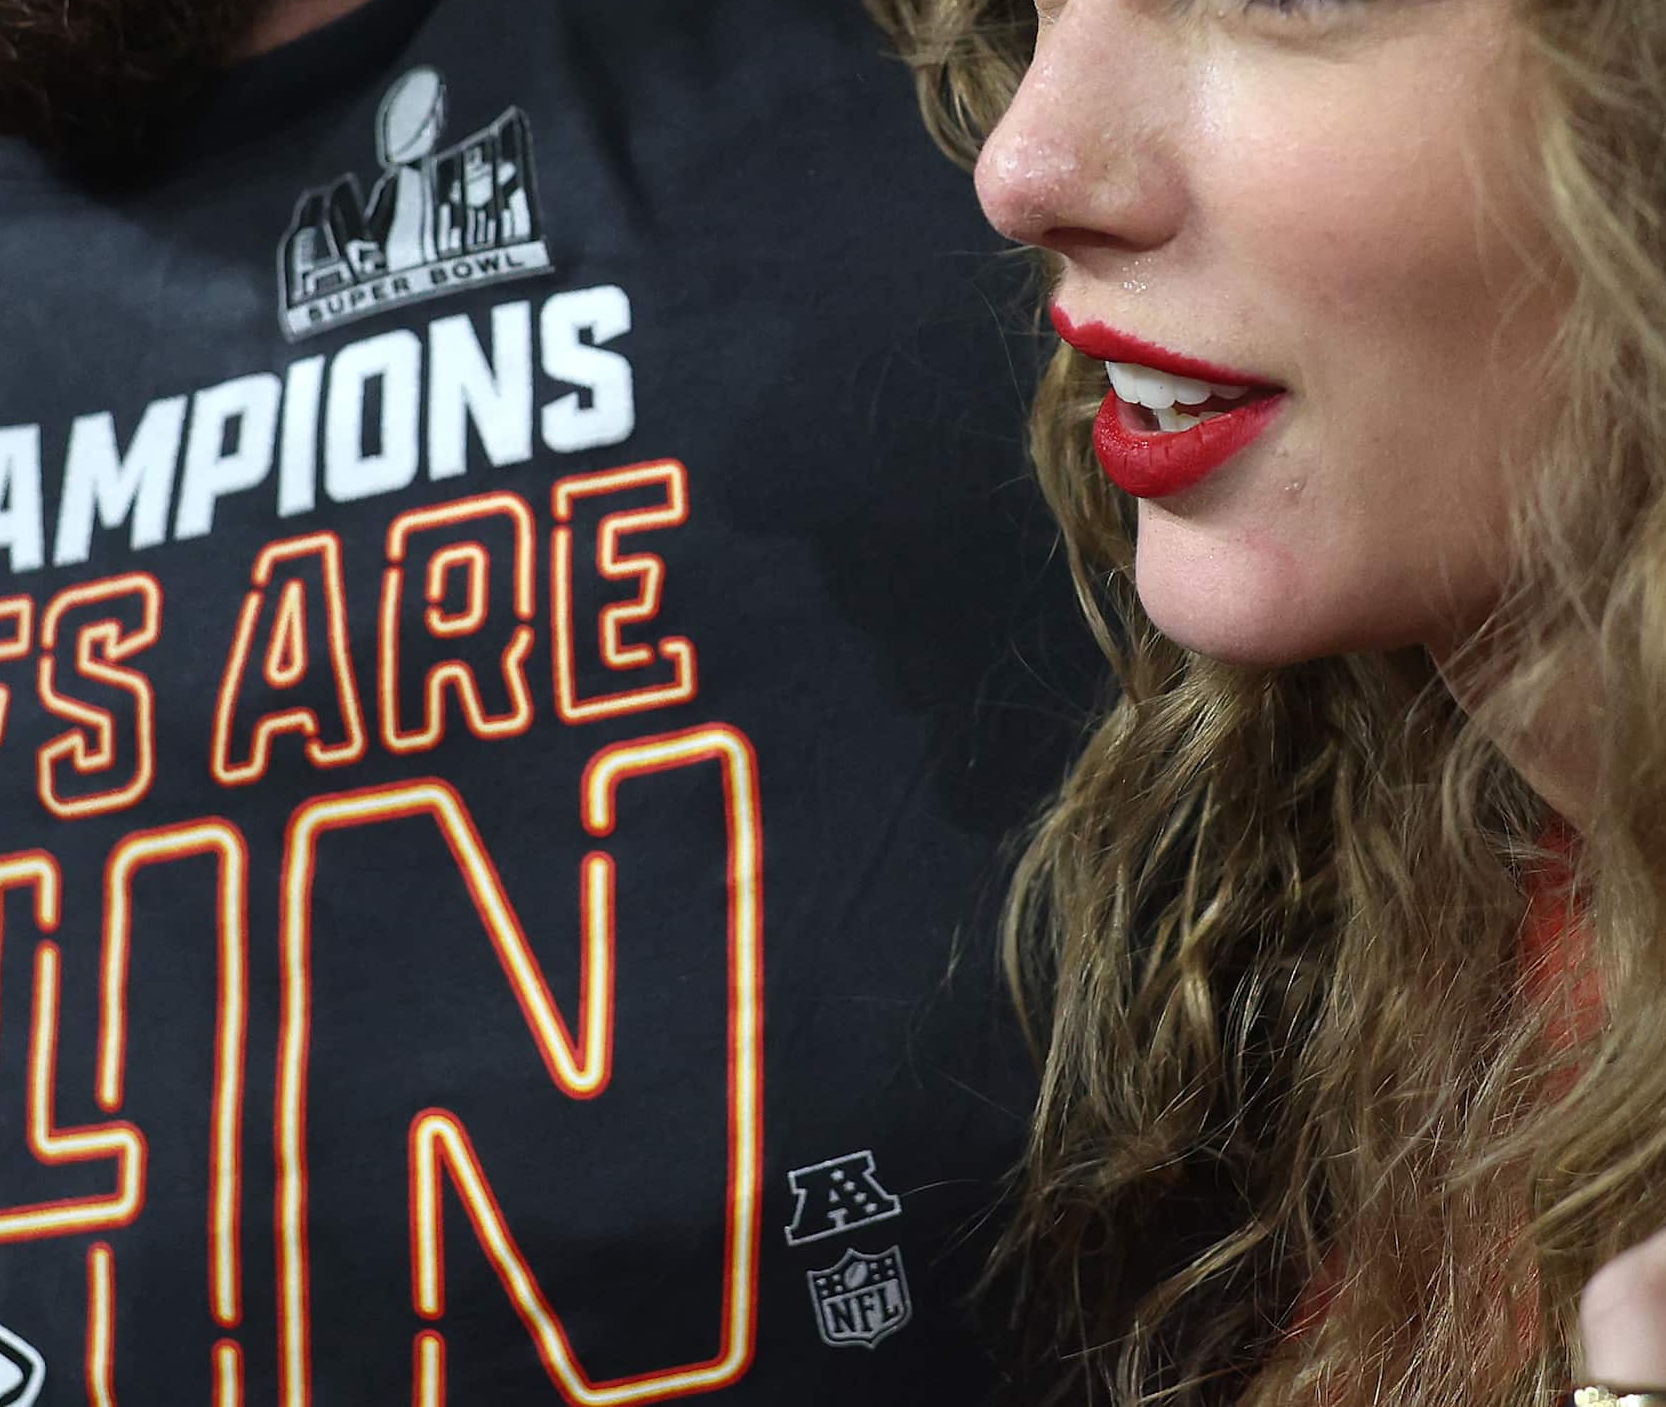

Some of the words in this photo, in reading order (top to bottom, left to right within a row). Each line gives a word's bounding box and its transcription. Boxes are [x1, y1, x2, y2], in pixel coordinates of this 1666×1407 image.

[306, 275, 412, 324] SUPER
[429, 249, 526, 284] BOWL
[210, 458, 697, 787] ARE
[826, 1284, 903, 1334] NFL
